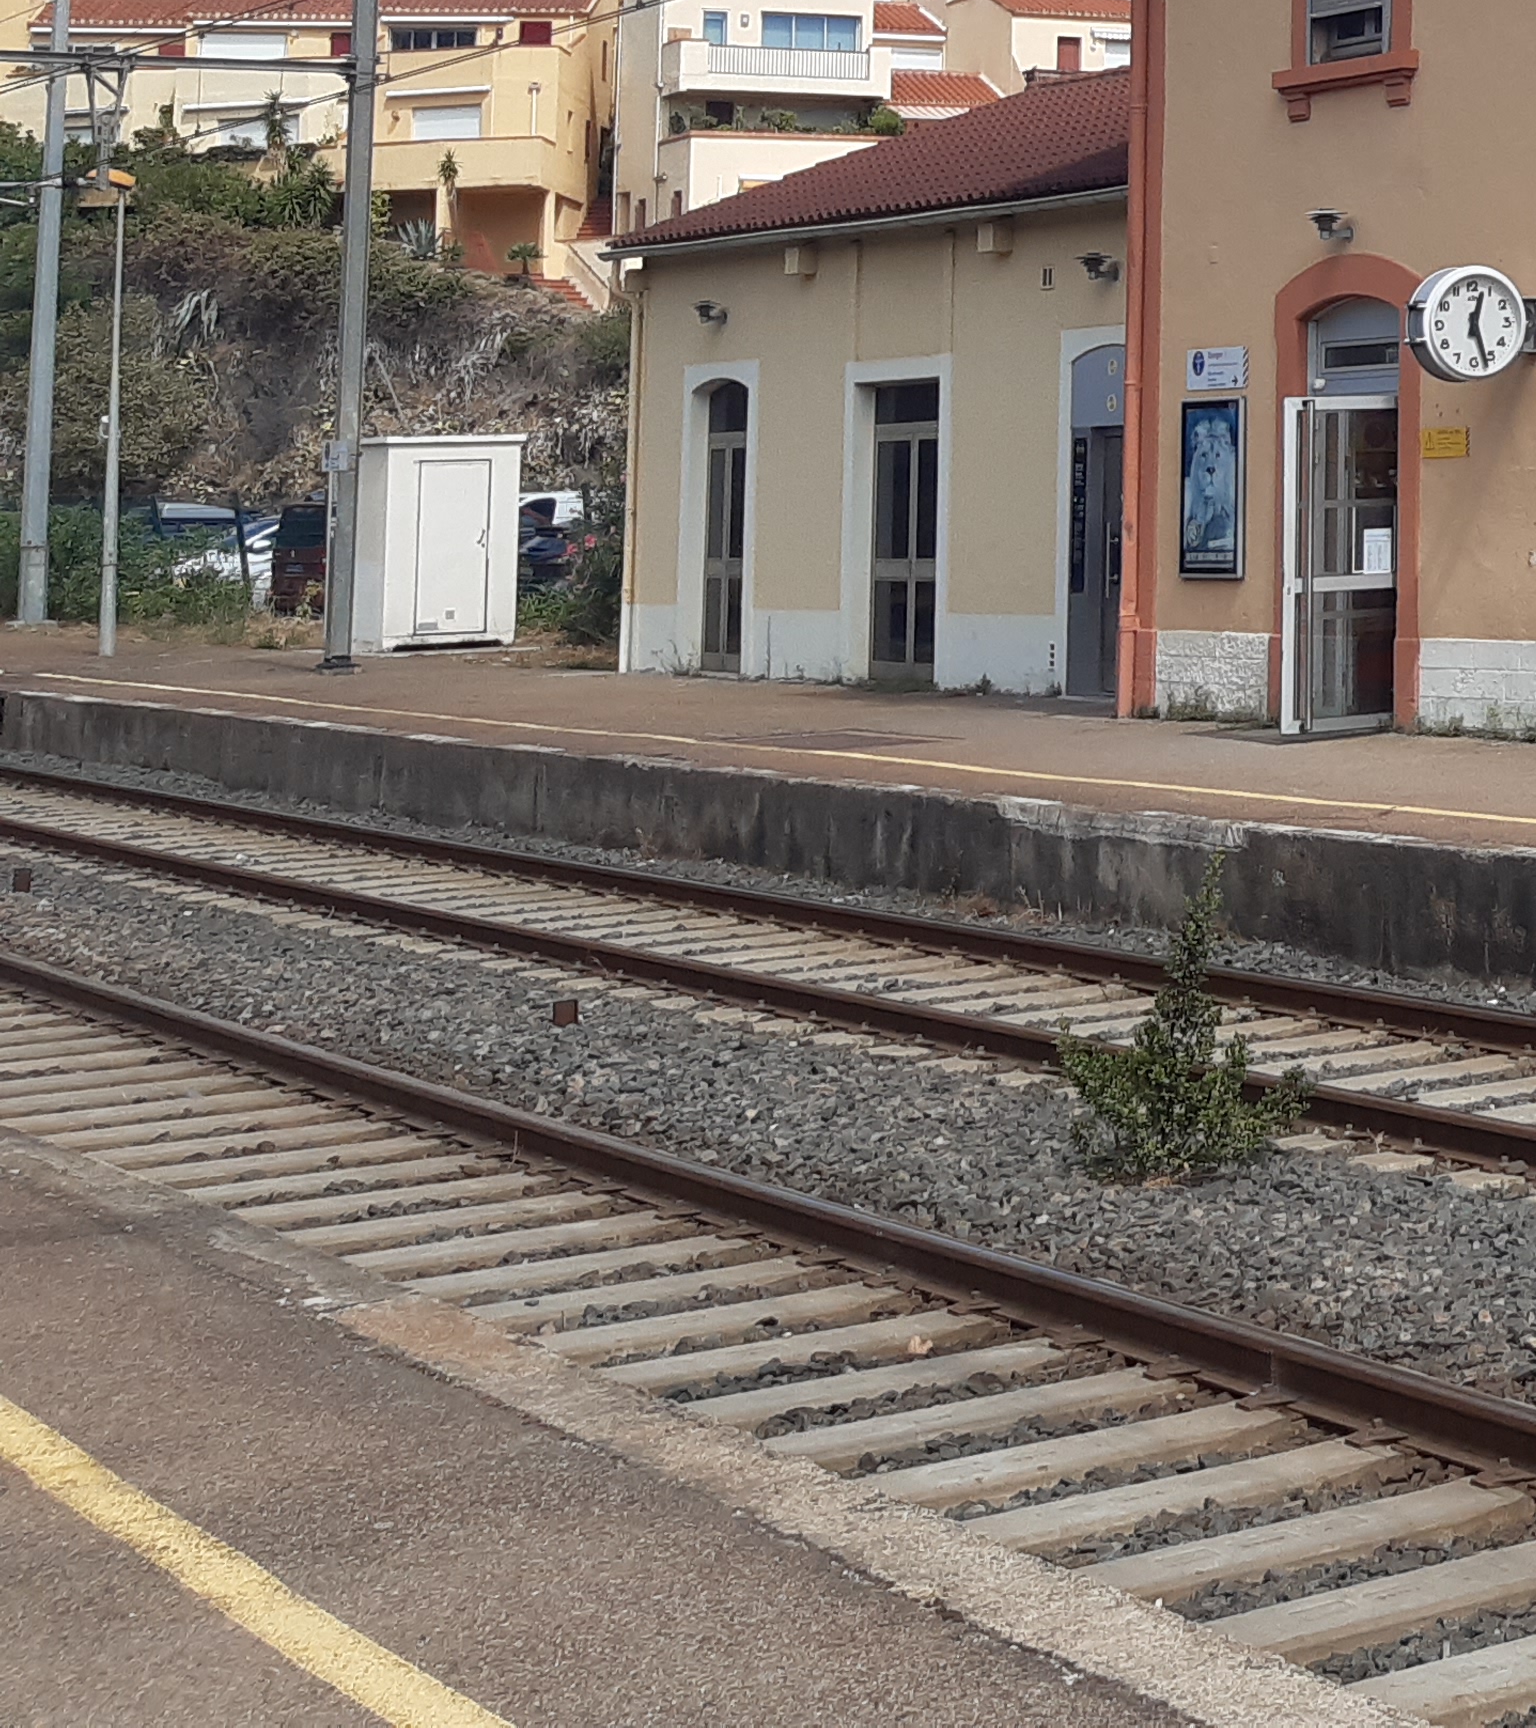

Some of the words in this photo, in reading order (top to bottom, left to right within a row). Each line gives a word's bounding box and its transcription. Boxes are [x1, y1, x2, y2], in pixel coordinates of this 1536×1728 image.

[1452, 285, 1460, 297] 11
[1466, 280, 1479, 293] 12
[1487, 285, 1492, 297] 1
[1439, 300, 1450, 312] 10
[1498, 299, 1507, 311] 2
[1434, 319, 1445, 331] 9
[1502, 316, 1512, 328] 3
[1440, 338, 1450, 350] 8
[1496, 336, 1507, 347] 4
[1452, 352, 1462, 364] 7
[1469, 356, 1479, 368] 6
[1487, 350, 1496, 362] 5
